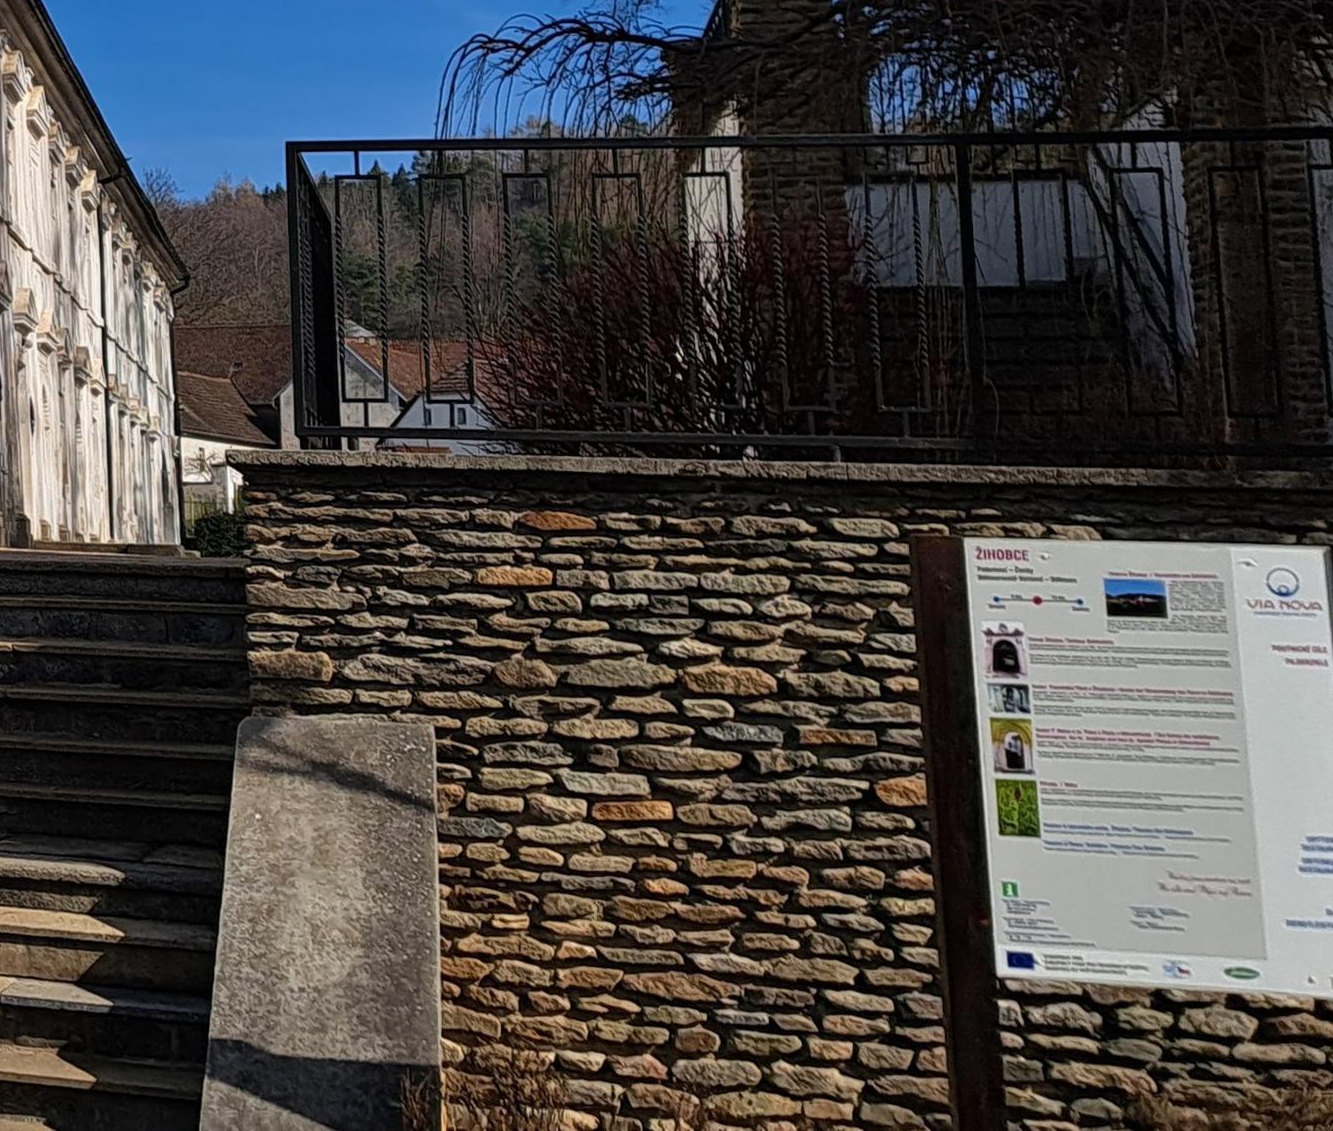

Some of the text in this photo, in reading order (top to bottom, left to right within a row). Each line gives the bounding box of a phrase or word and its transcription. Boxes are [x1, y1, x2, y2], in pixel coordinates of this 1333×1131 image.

[976, 546, 1029, 561] ŽIHOBCE
[1245, 598, 1323, 611] VIA NOVA
